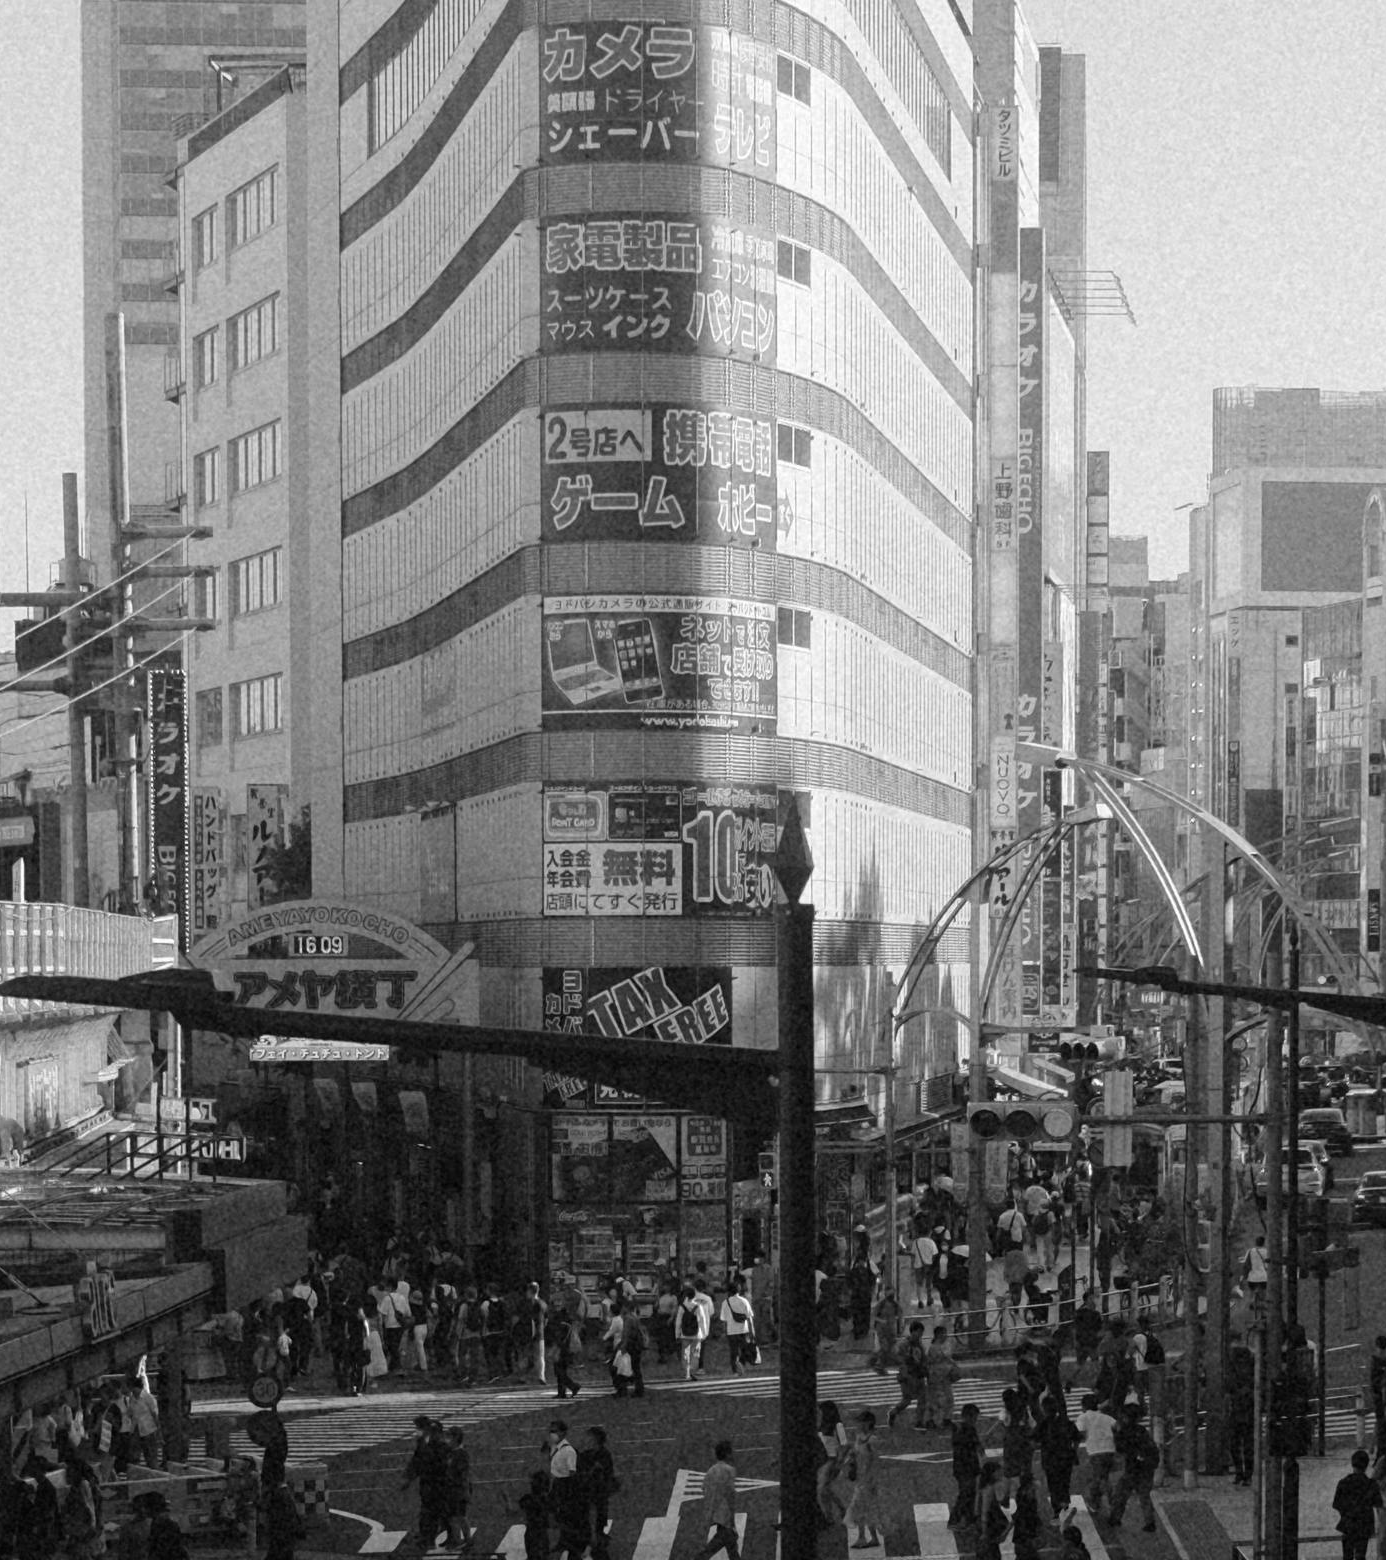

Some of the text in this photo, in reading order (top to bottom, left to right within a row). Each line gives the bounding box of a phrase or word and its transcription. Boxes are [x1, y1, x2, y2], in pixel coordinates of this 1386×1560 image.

[543, 24, 696, 83] カメラ
[606, 90, 705, 118] ドライヤー
[548, 117, 700, 153] シェーバー
[714, 102, 771, 168] テレビ
[546, 221, 702, 274] 家電製品
[546, 286, 671, 313] スーツケース
[686, 289, 775, 352] パソコン
[546, 314, 670, 340] マウス インク
[548, 408, 773, 478] 2号店へ 携帯電話
[550, 473, 686, 531] ゲーム
[716, 480, 773, 535] ホビー
[996, 754, 1011, 815] NUOVO
[547, 849, 591, 867] 入会金
[547, 870, 591, 888] 年会費
[603, 849, 676, 887] 無料
[546, 893, 678, 911] 店頭にてすぐ発行
[227, 905, 410, 948] AMEYAYOKOCHO
[233, 969, 418, 1010] アメヤ横丁
[586, 966, 683, 1038] TAX
[652, 982, 730, 1045] FREE
